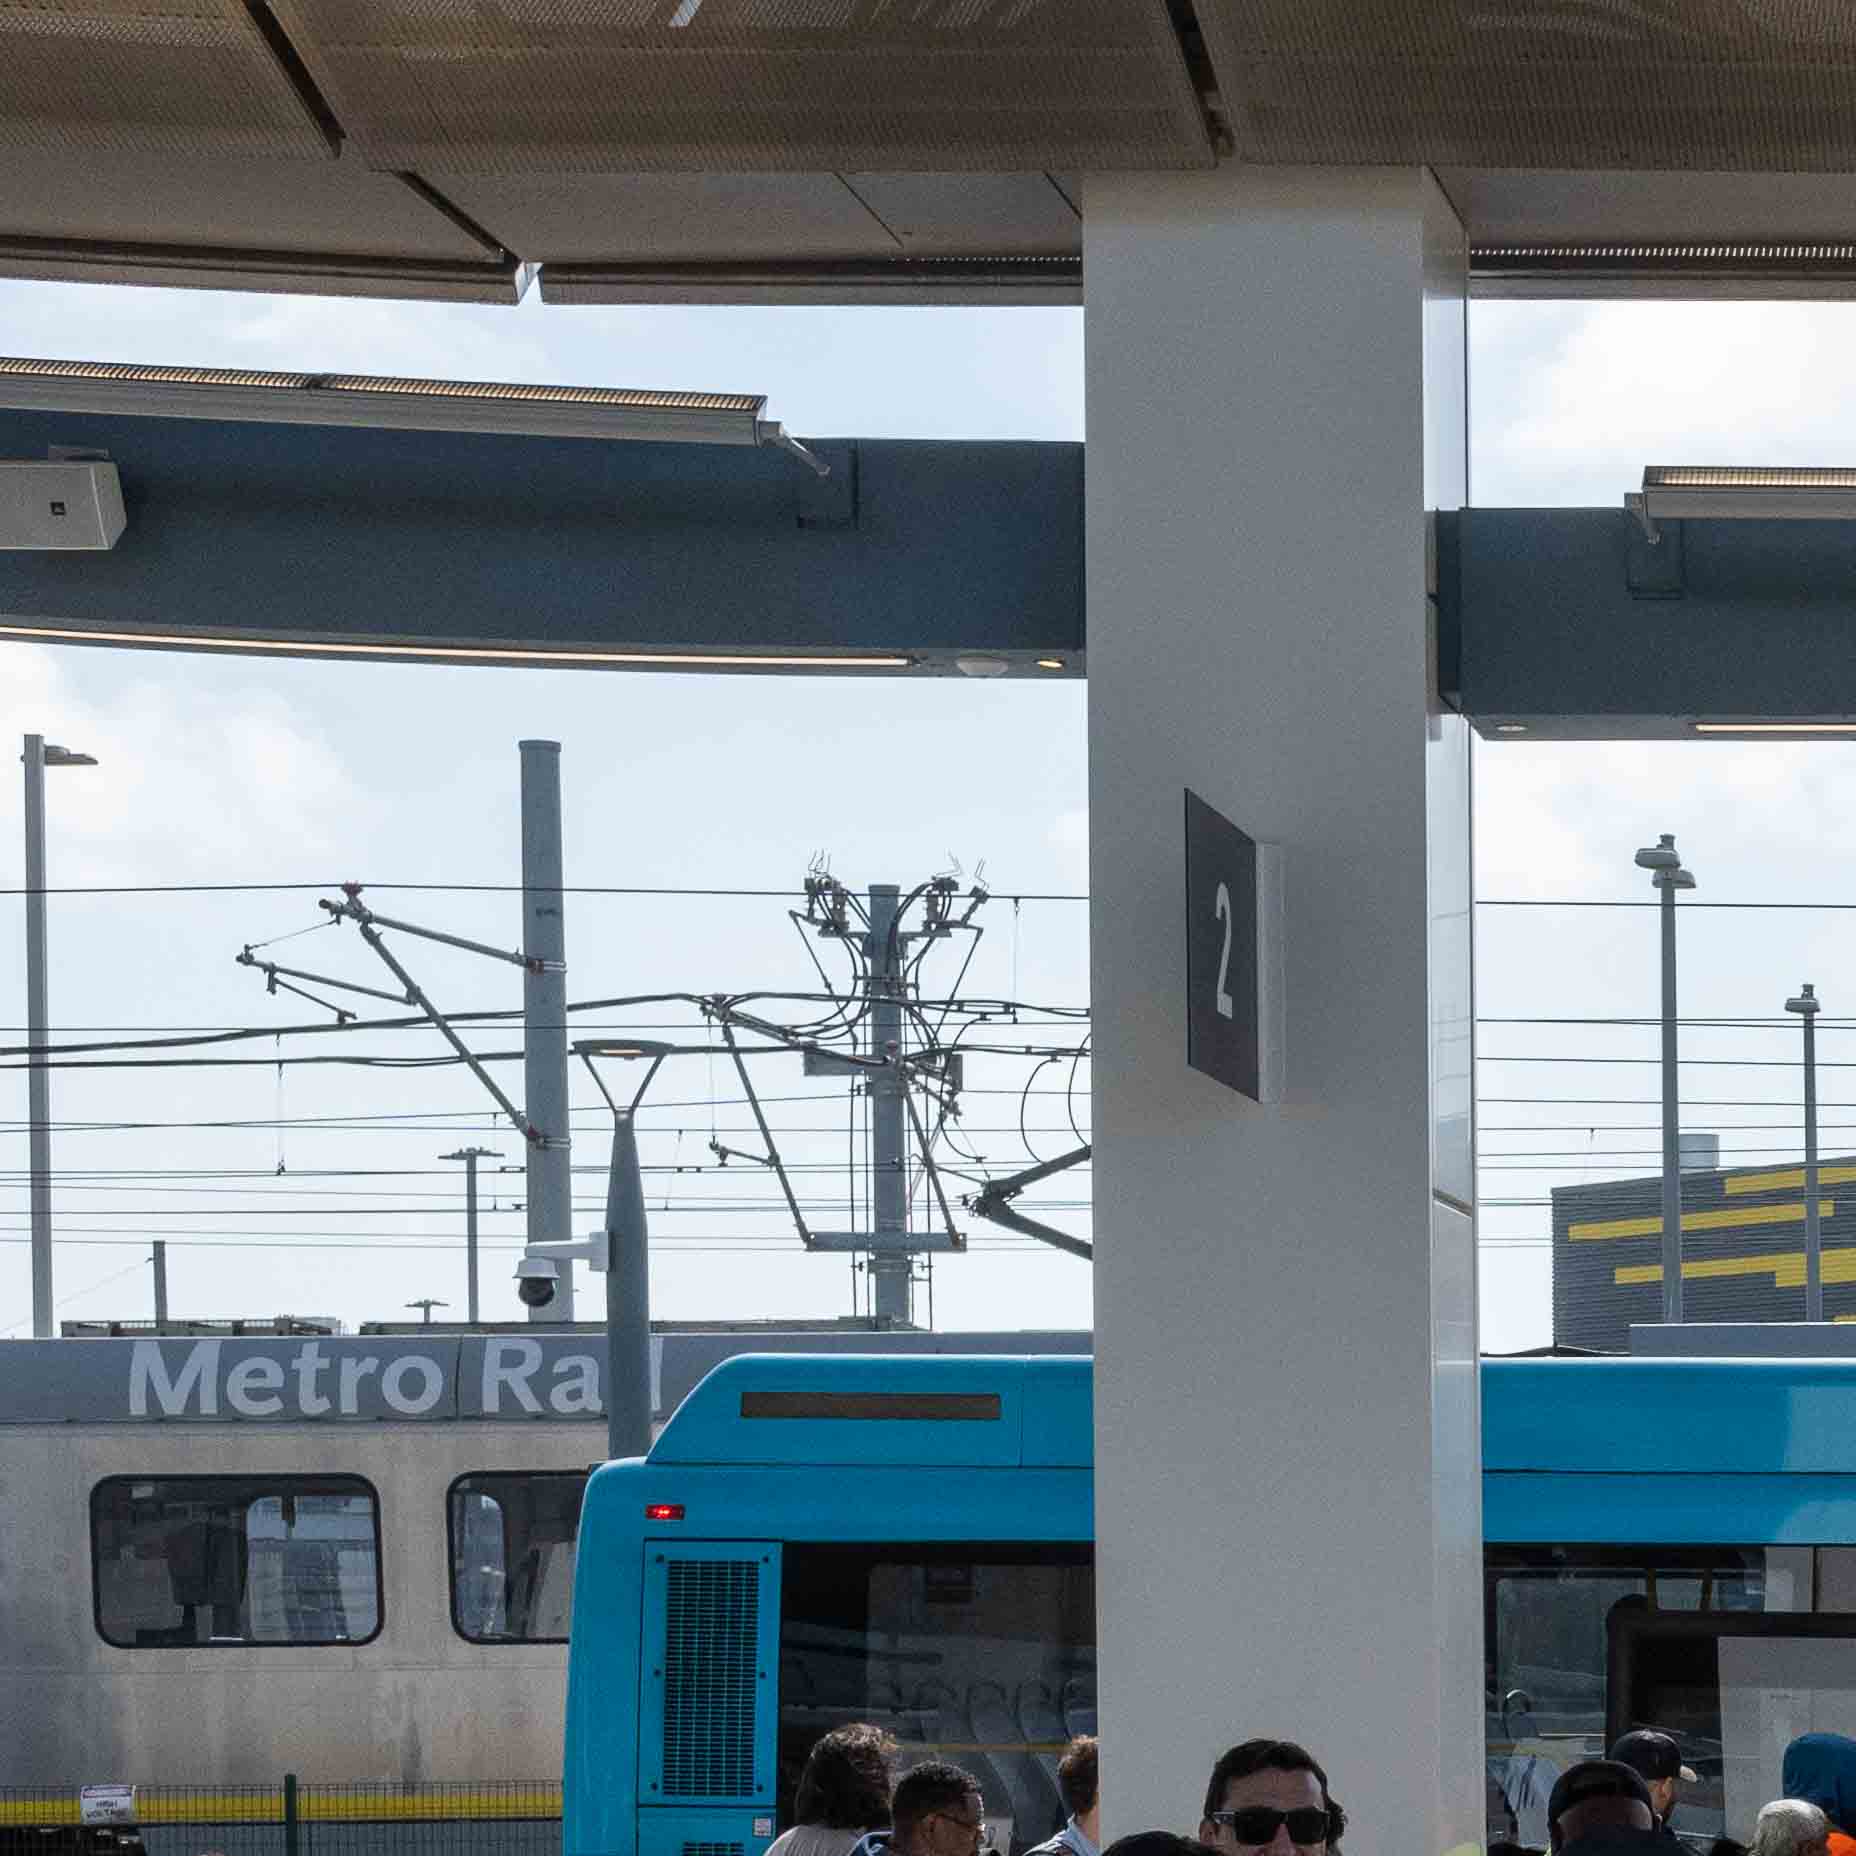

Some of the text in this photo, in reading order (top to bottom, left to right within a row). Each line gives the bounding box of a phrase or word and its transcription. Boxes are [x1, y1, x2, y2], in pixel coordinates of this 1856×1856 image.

[1215, 881, 1233, 1019] 2
[129, 1336, 663, 1415] Metro Ral
